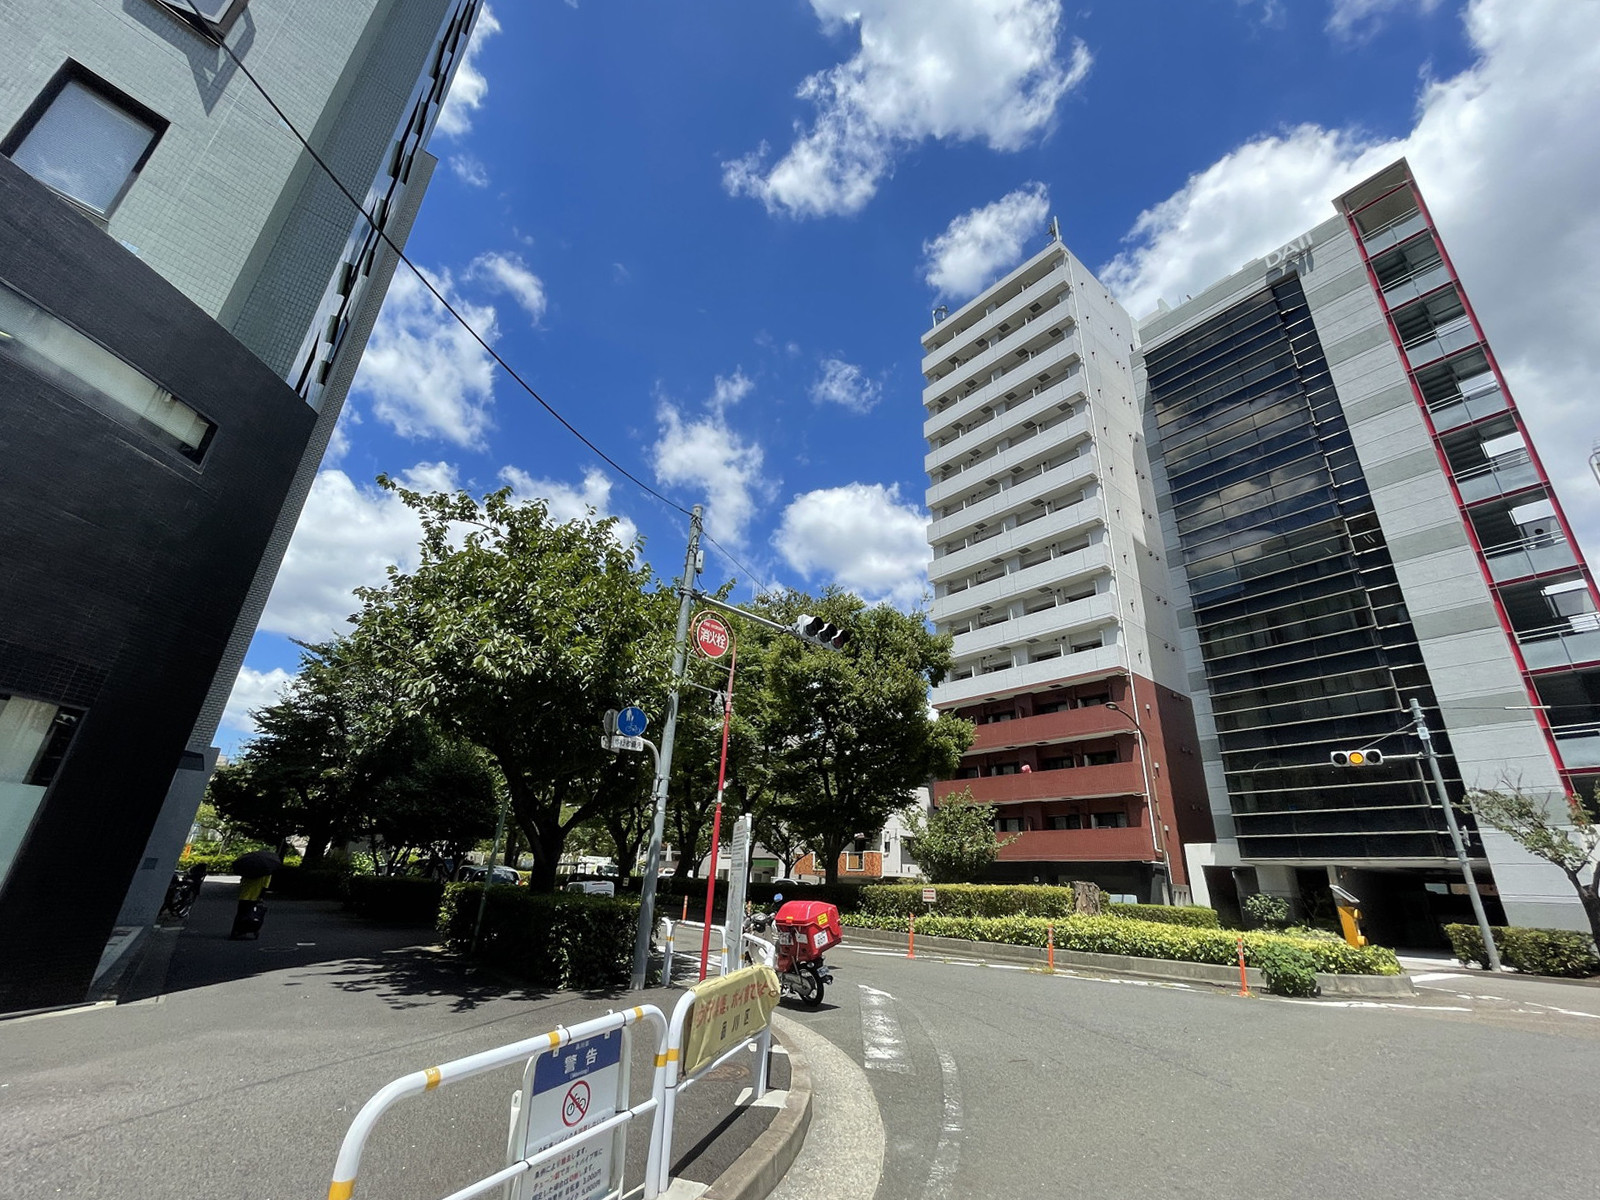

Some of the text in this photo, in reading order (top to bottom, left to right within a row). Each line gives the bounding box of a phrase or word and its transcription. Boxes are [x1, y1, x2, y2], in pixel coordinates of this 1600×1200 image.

[700, 626, 727, 649] 消火栓
[720, 1008, 750, 1041] 品川区
[564, 1047, 597, 1074] 警告
